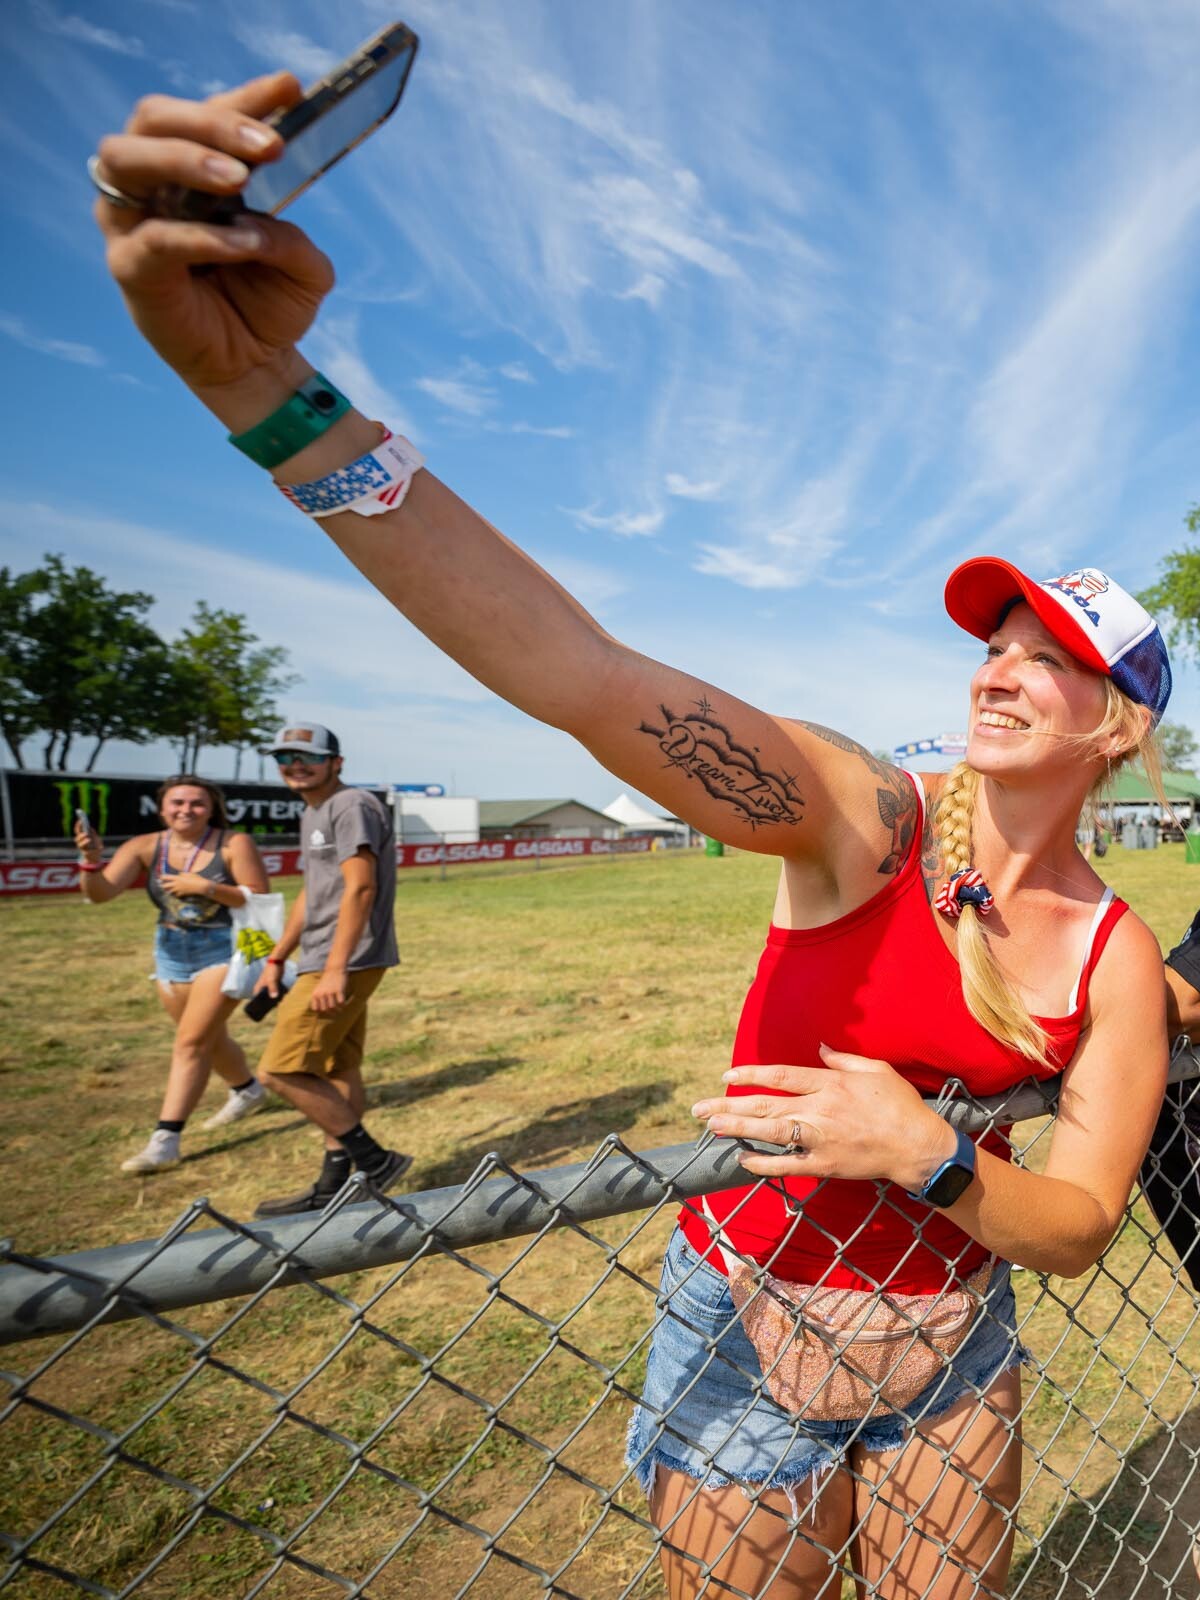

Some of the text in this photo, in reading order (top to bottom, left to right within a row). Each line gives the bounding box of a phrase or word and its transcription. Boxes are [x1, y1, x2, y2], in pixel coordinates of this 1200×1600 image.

[659, 724, 736, 791] Dream
[415, 843, 505, 863] GASGAS
[514, 840, 585, 857] GASGAS
